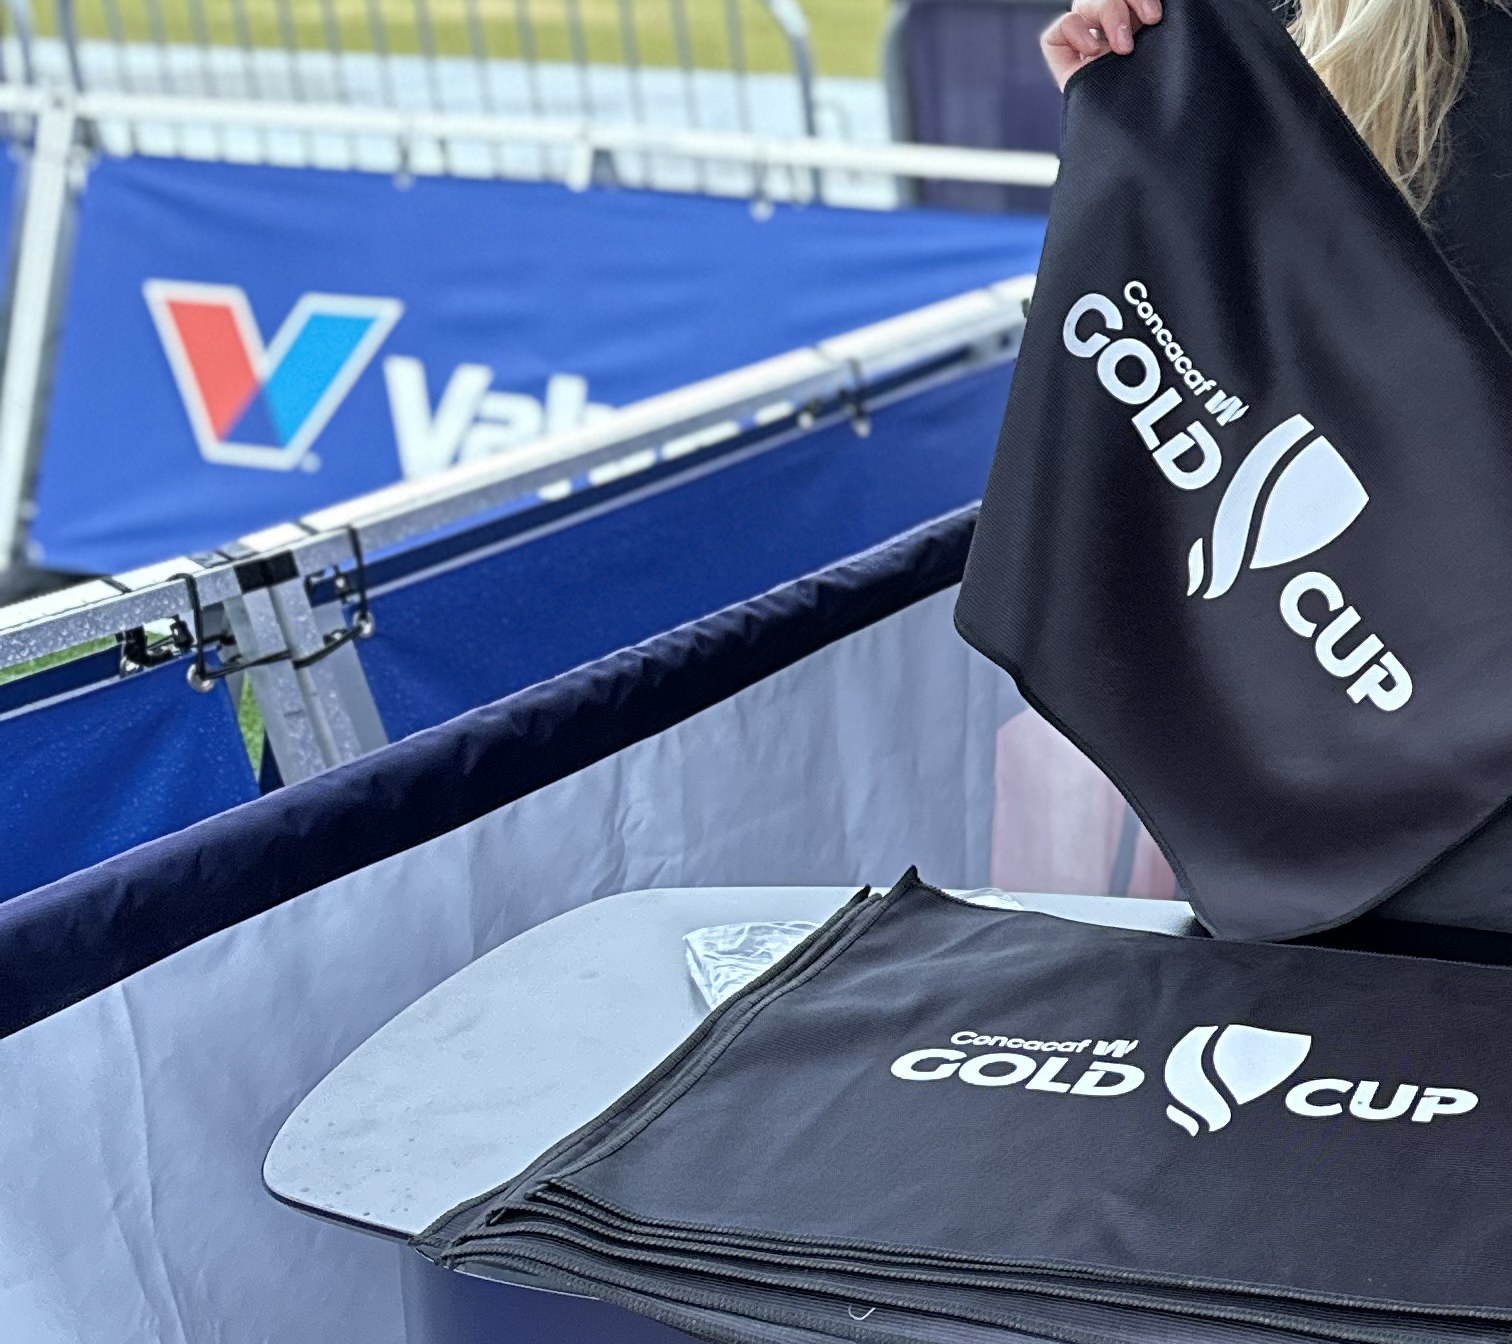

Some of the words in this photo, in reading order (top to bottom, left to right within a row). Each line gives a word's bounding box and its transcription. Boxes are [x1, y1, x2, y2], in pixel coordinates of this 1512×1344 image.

[1123, 280, 1217, 396] Concacaf
[1062, 293, 1222, 490] GOLD
[1279, 571, 1413, 712] CUP
[890, 1048, 1145, 1097] GOLD
[1284, 1078, 1479, 1123] CUP
[950, 1030, 1092, 1055] Concacaf
